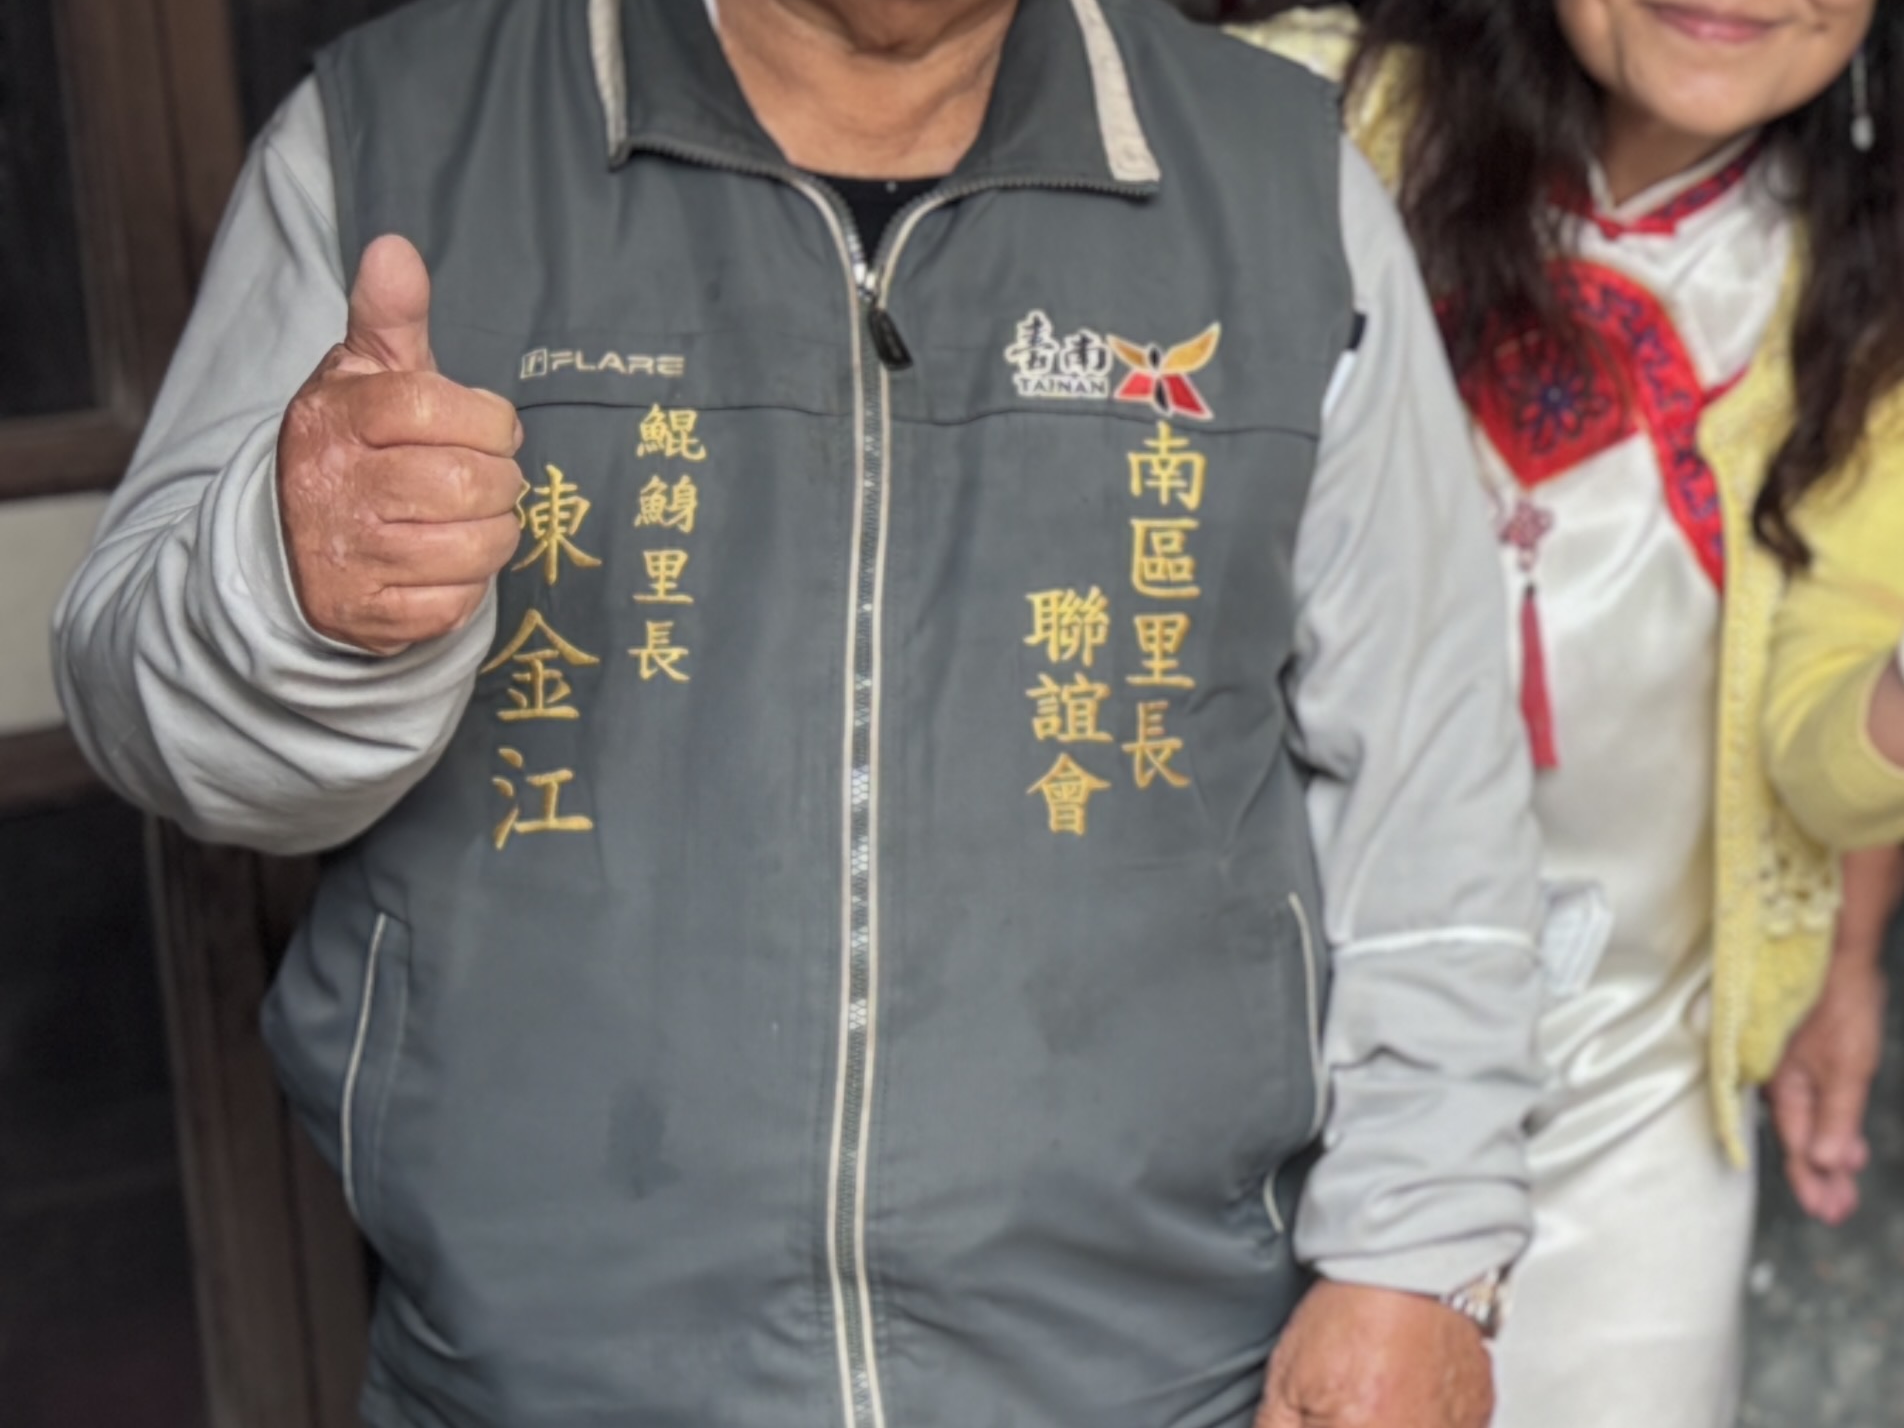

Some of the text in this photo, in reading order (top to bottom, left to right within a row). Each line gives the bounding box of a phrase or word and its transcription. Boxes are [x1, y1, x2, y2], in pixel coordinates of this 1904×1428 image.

[549, 348, 686, 378] FLARE
[1017, 376, 1107, 396] TAINAN
[478, 462, 603, 851] 陳金江
[628, 402, 708, 683] 鯤鯓里長
[1121, 419, 1208, 790] 南區里長
[1022, 584, 1115, 837] 聯誼會
